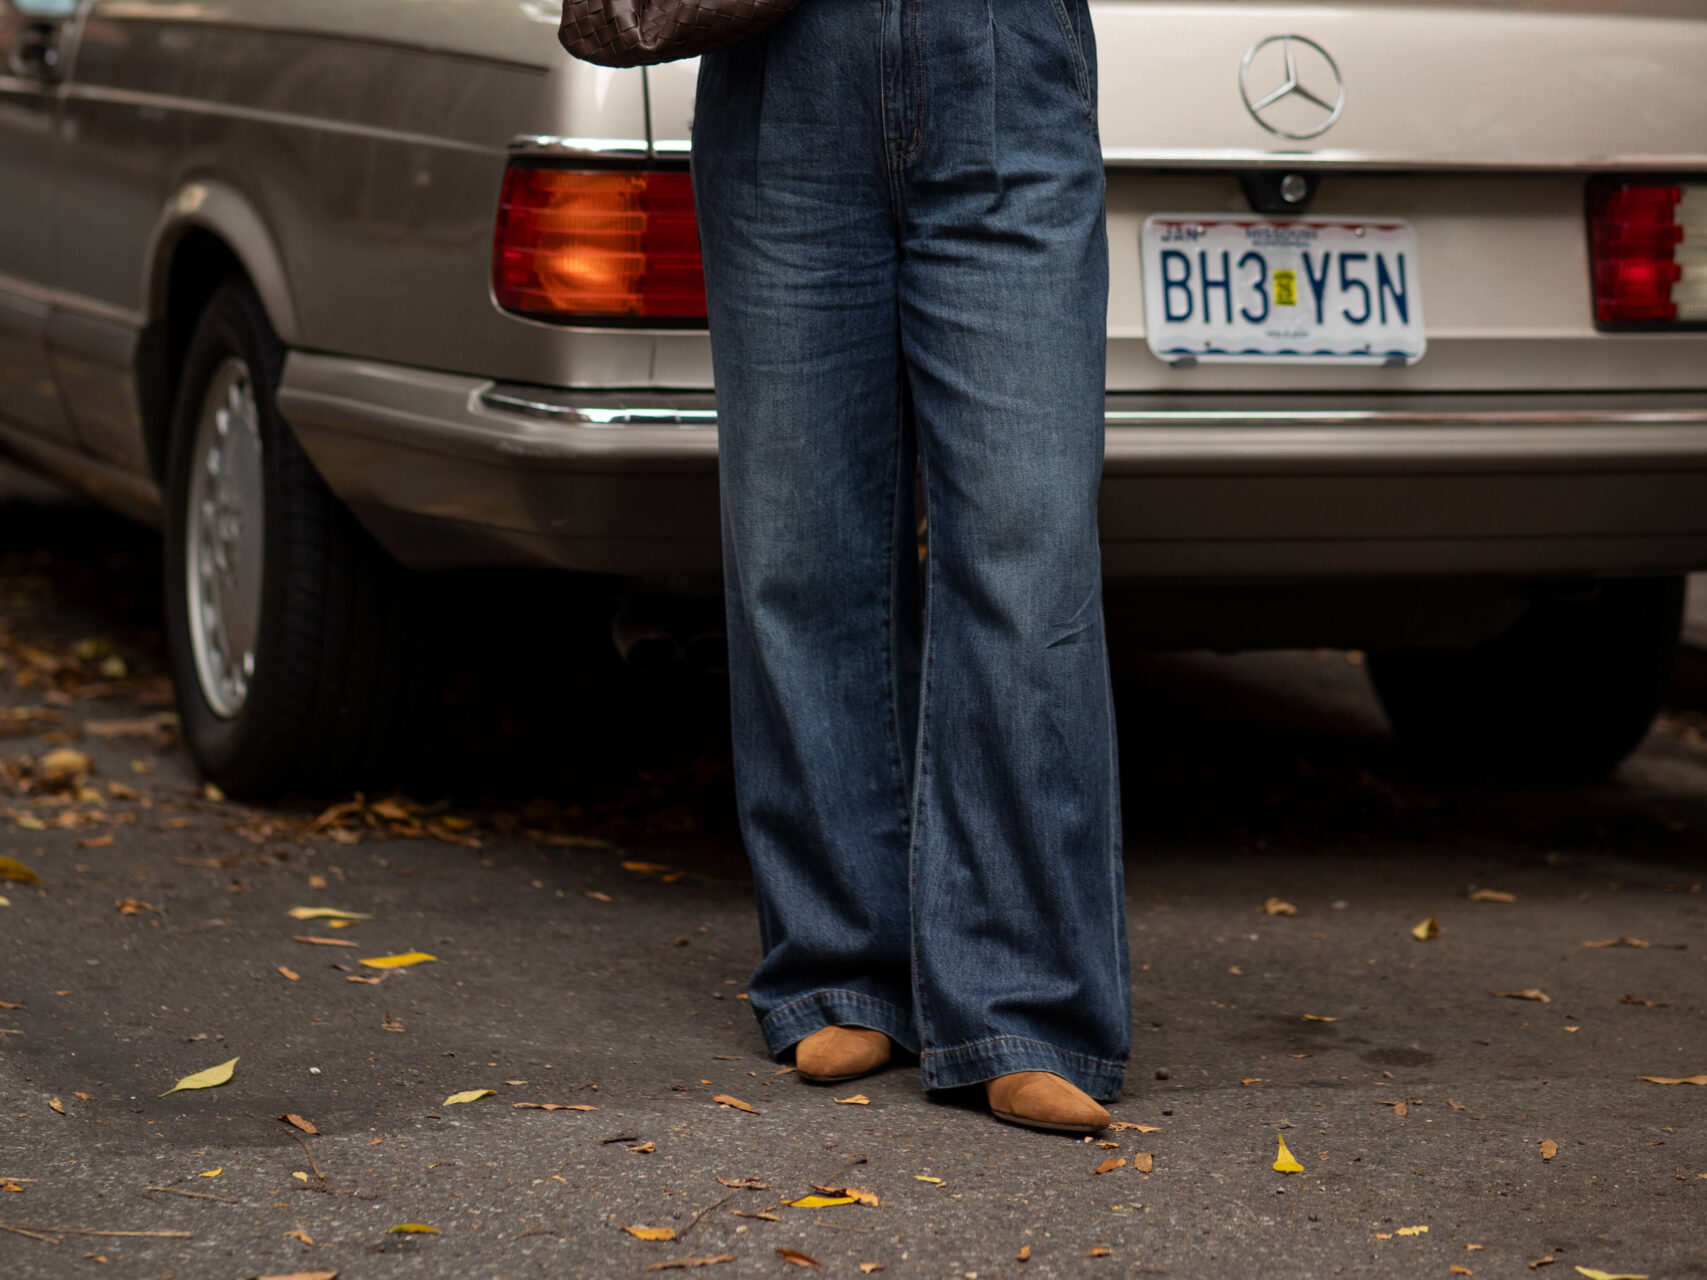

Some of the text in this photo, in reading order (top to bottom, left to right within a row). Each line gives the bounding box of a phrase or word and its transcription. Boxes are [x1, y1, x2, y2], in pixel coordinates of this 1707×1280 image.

[1161, 228, 1198, 242] JAN
[1246, 230, 1317, 241] MISSOURI
[1161, 251, 1270, 324] BH3
[1303, 252, 1408, 326] Y5N
